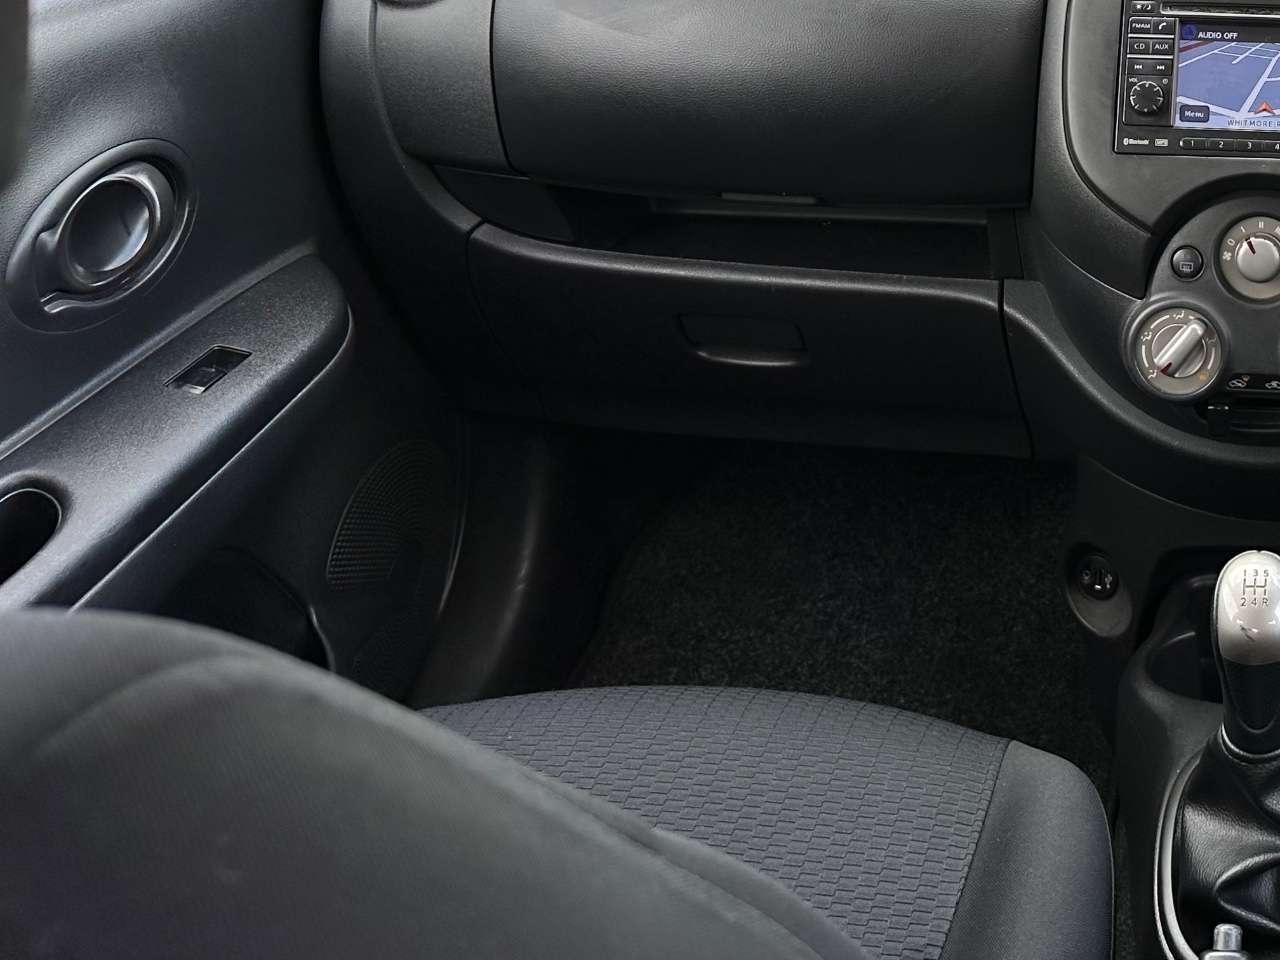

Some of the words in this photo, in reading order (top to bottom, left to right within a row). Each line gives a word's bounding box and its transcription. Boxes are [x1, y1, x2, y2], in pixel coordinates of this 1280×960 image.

[1198, 31, 1222, 39] AUDIO
[1223, 32, 1239, 40] OFF
[1184, 110, 1205, 119] Menu
[1252, 569, 1259, 577] 3
[1263, 569, 1270, 578] 5
[1240, 597, 1247, 607] 2
[1251, 597, 1258, 607] 4
[1262, 597, 1269, 607] R
